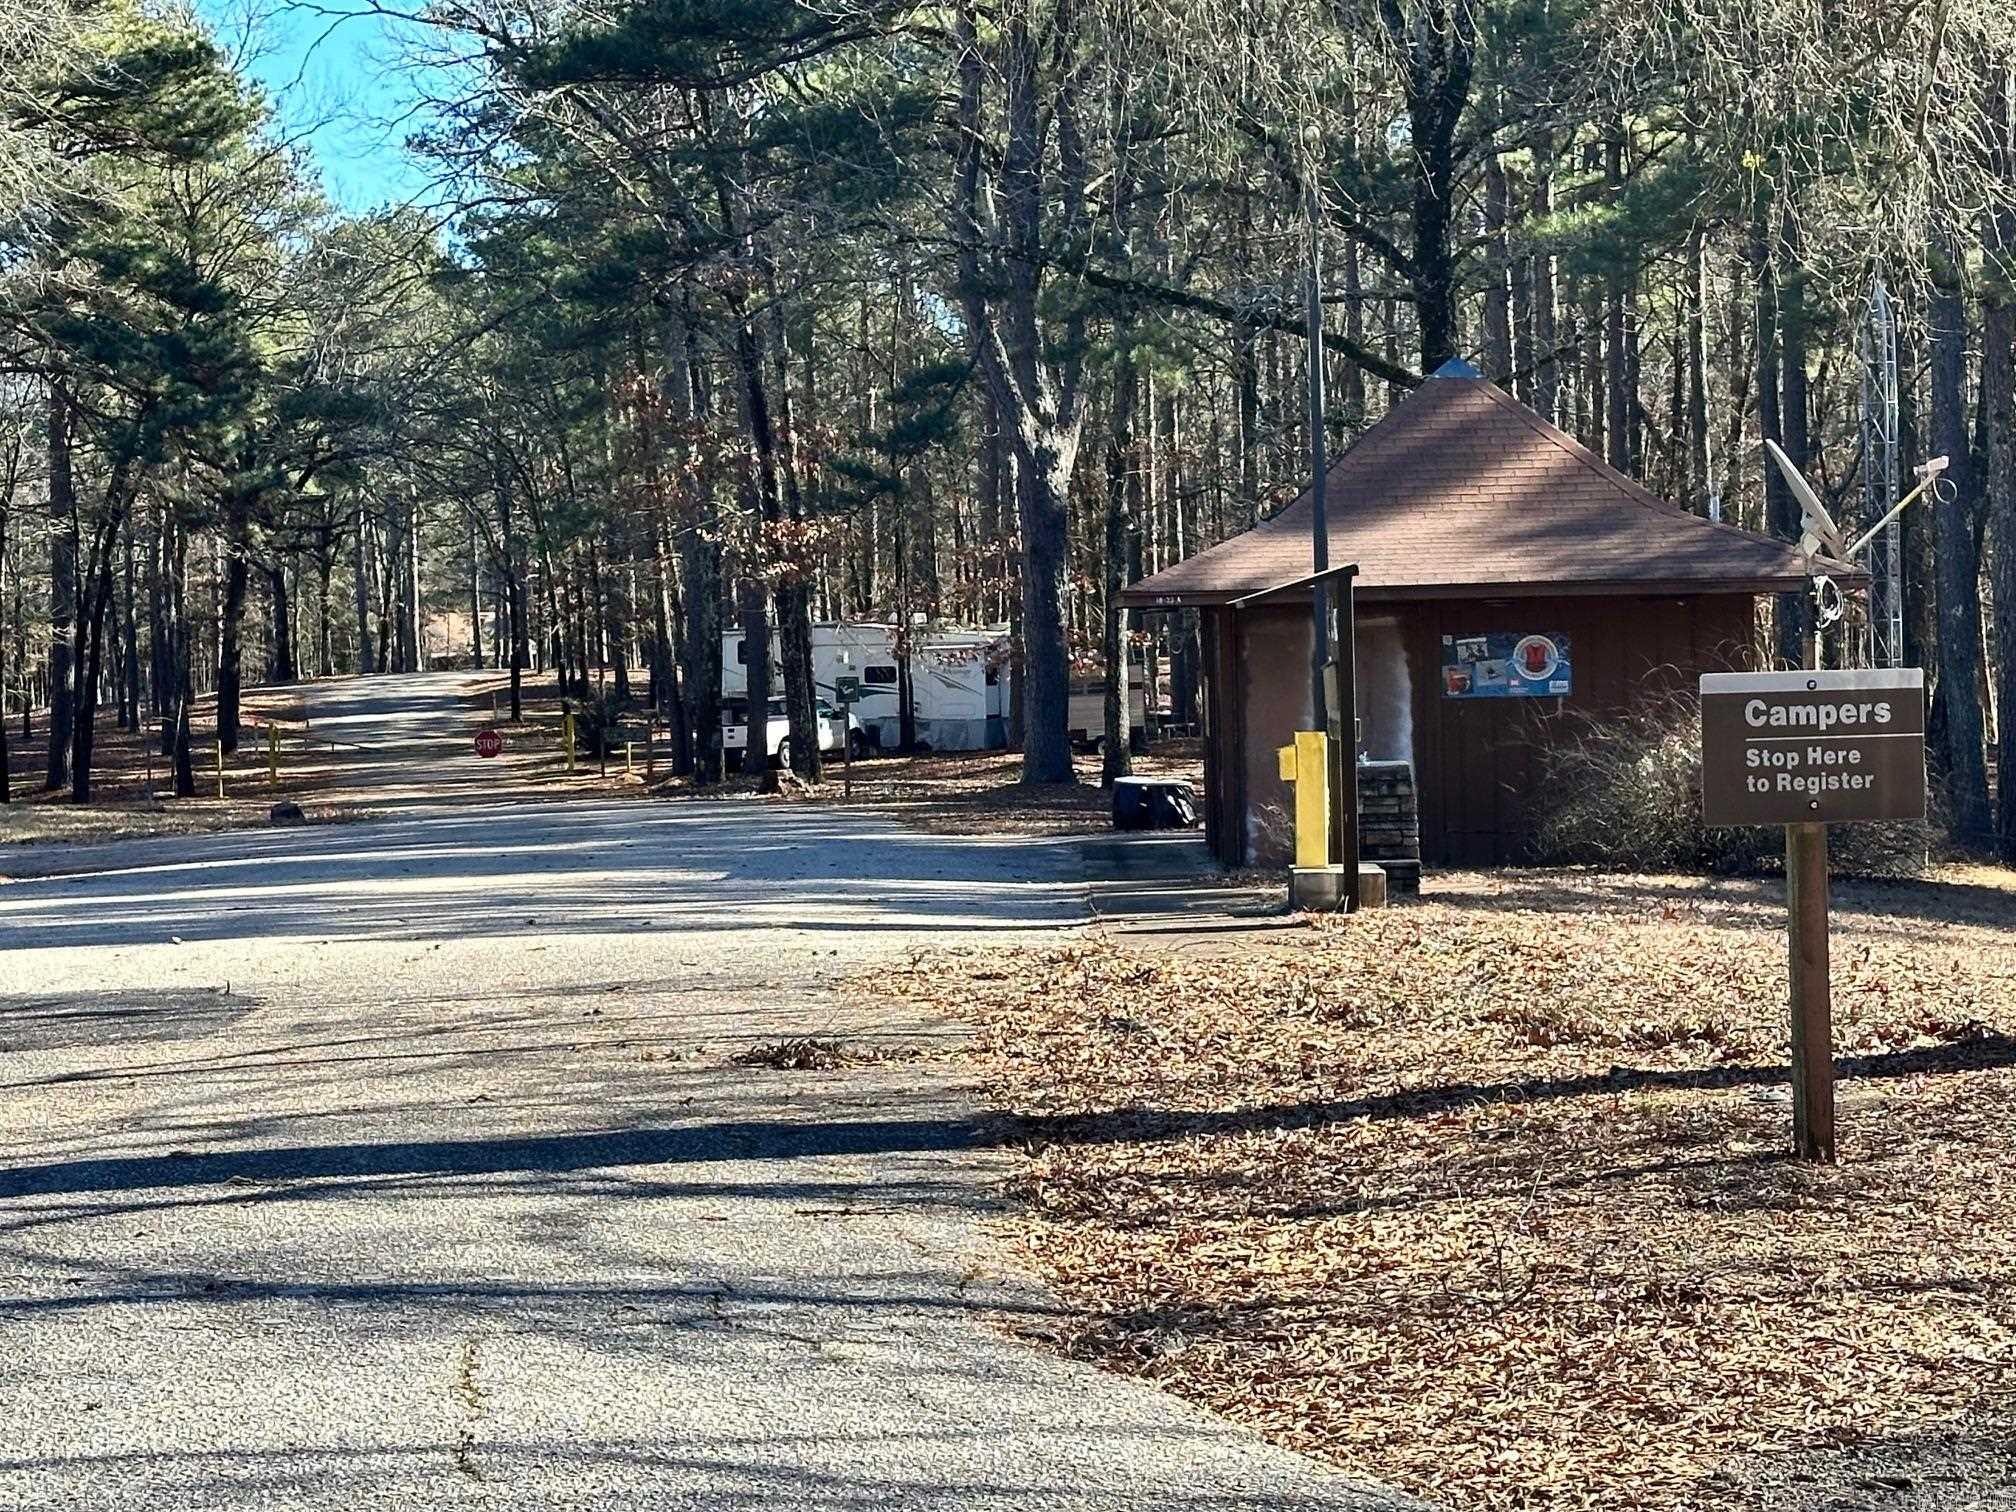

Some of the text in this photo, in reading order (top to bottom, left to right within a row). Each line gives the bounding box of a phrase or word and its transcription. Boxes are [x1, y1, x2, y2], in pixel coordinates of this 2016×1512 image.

[1745, 699, 1891, 730] Campers
[476, 739, 500, 749] STOP
[1746, 747, 1861, 769] Stop Here
[1746, 772, 1874, 794] to Register
